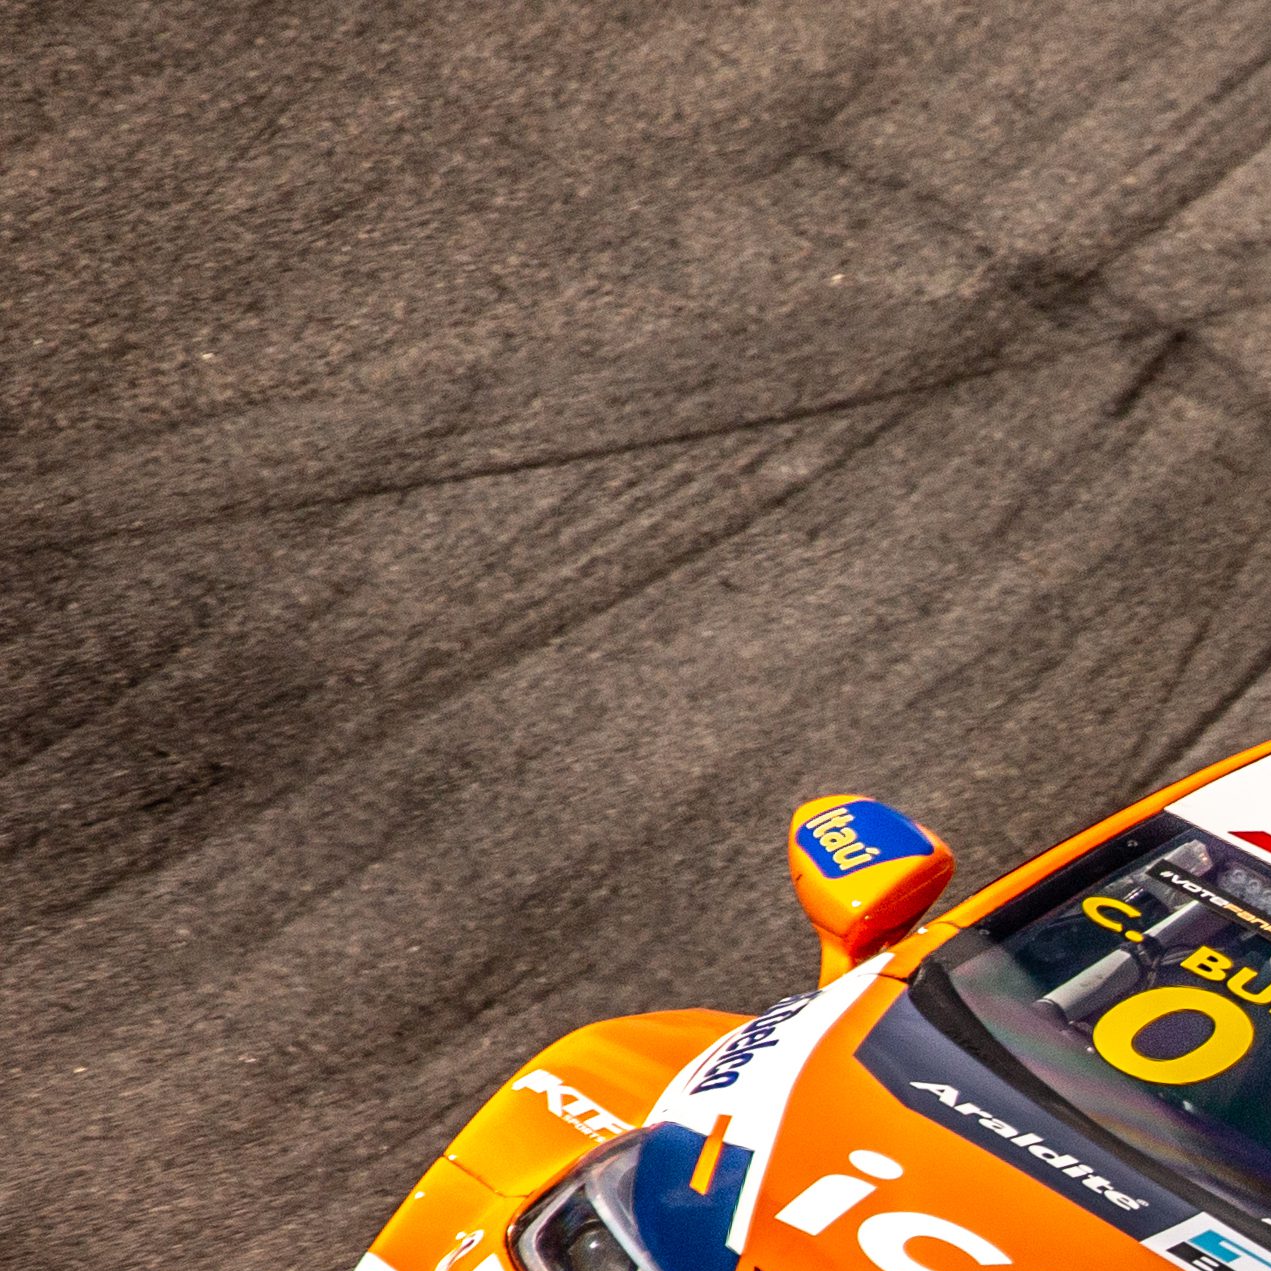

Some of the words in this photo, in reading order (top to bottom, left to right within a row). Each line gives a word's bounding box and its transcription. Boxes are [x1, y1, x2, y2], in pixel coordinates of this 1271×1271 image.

[806, 807, 880, 870] Itaú
[1081, 896, 1150, 942] C.
[689, 990, 823, 1095] Delco
[1092, 985, 1255, 1085] 0
